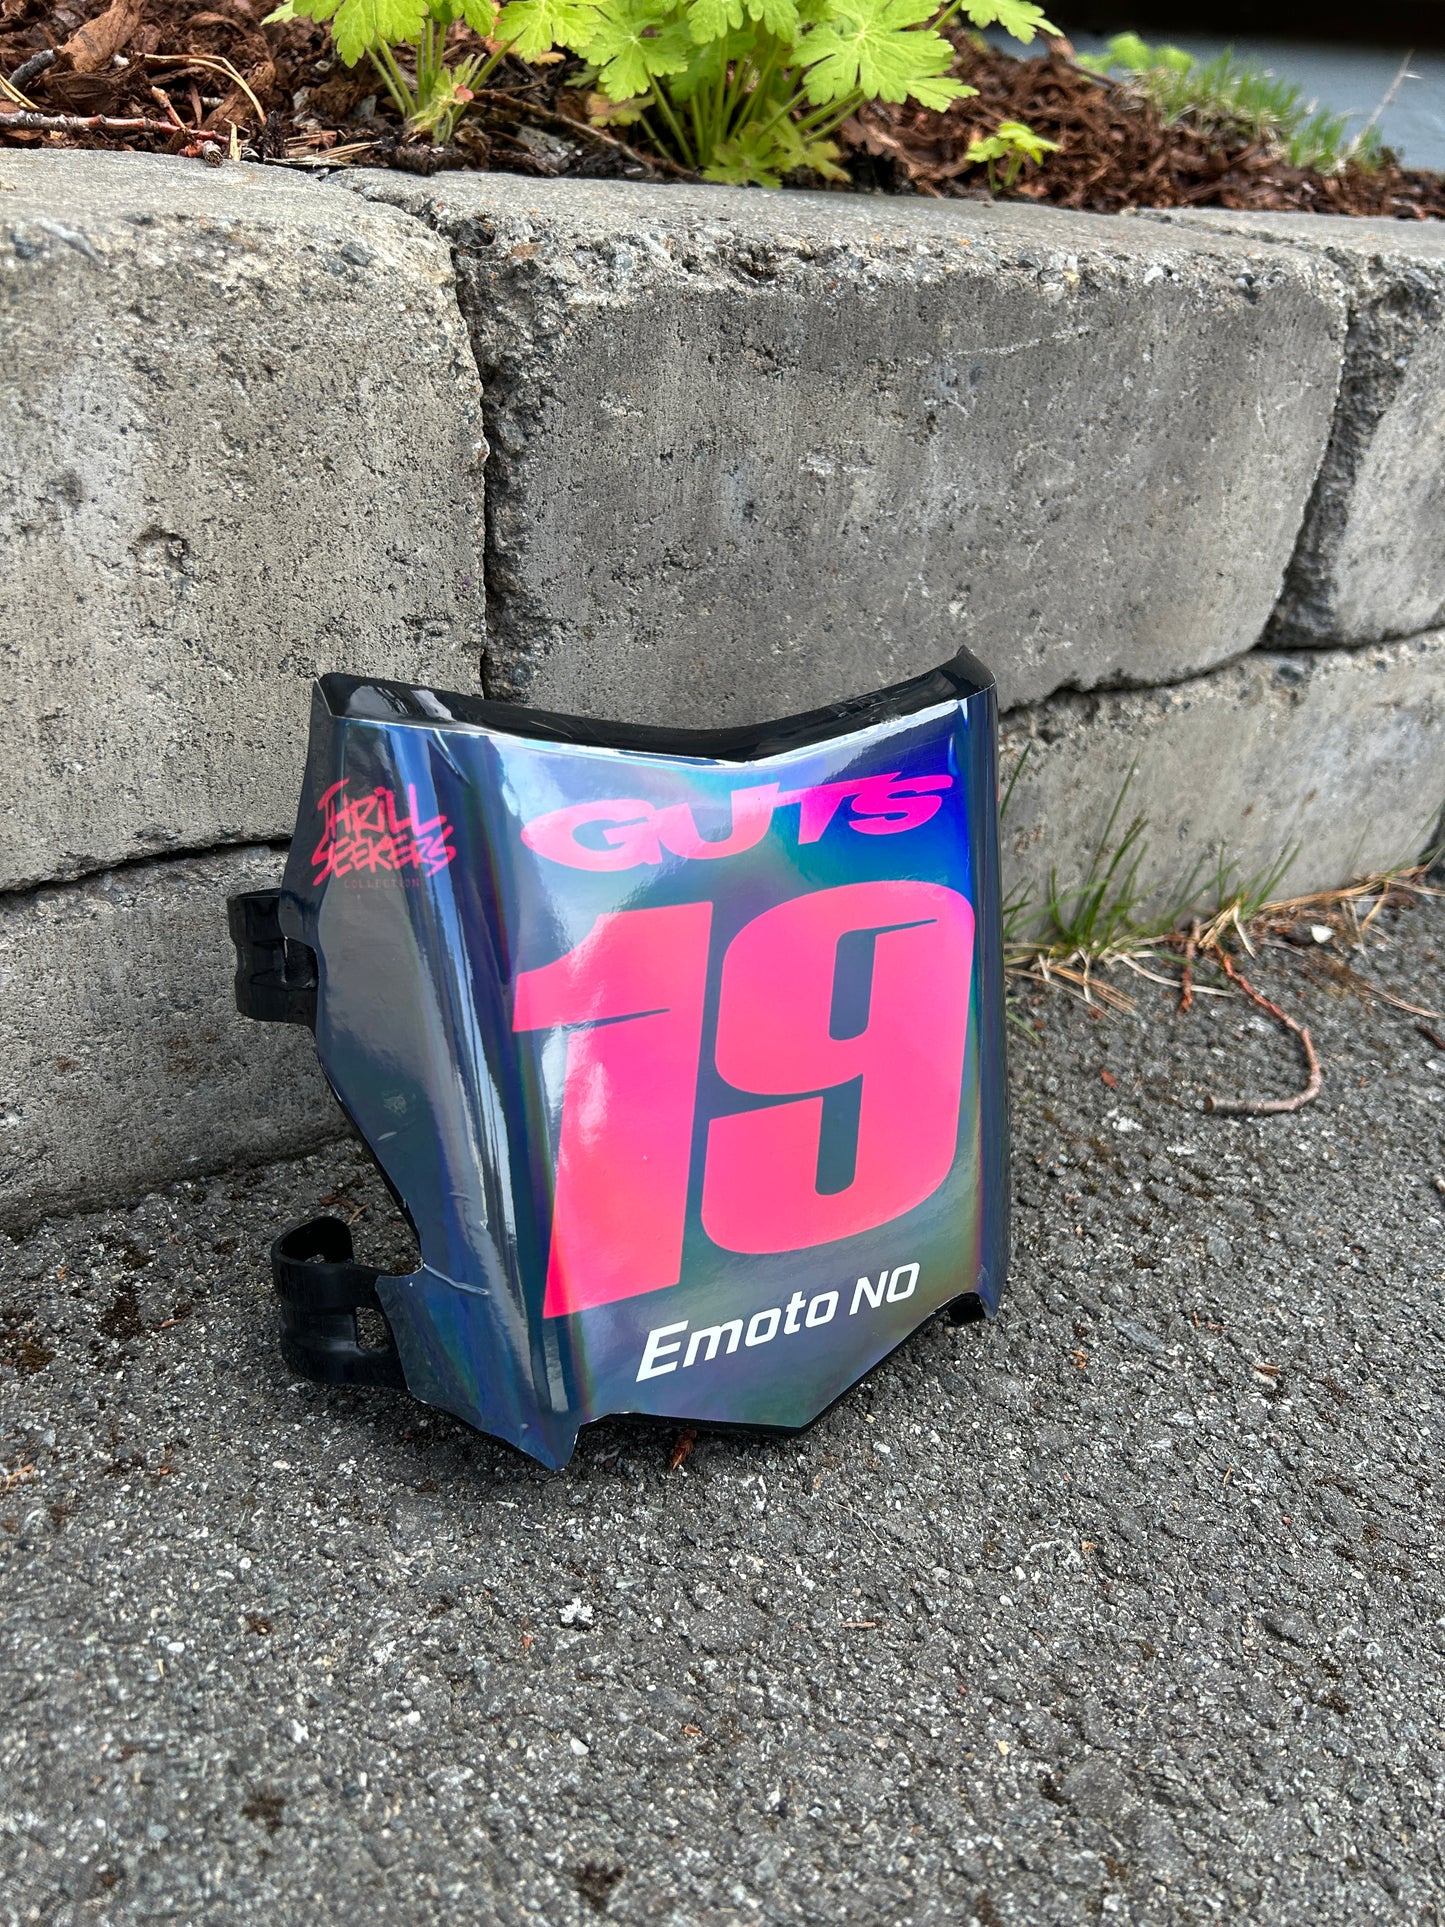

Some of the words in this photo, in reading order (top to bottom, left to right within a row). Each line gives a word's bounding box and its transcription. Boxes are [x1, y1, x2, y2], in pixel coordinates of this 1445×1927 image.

[311, 825, 457, 886] SEEKERS
[521, 772, 953, 872] GUTS
[343, 878, 420, 889] COLLECTION
[512, 880, 976, 1319] 19
[635, 1290, 840, 1383] Emoto
[849, 1262, 921, 1316] NO
